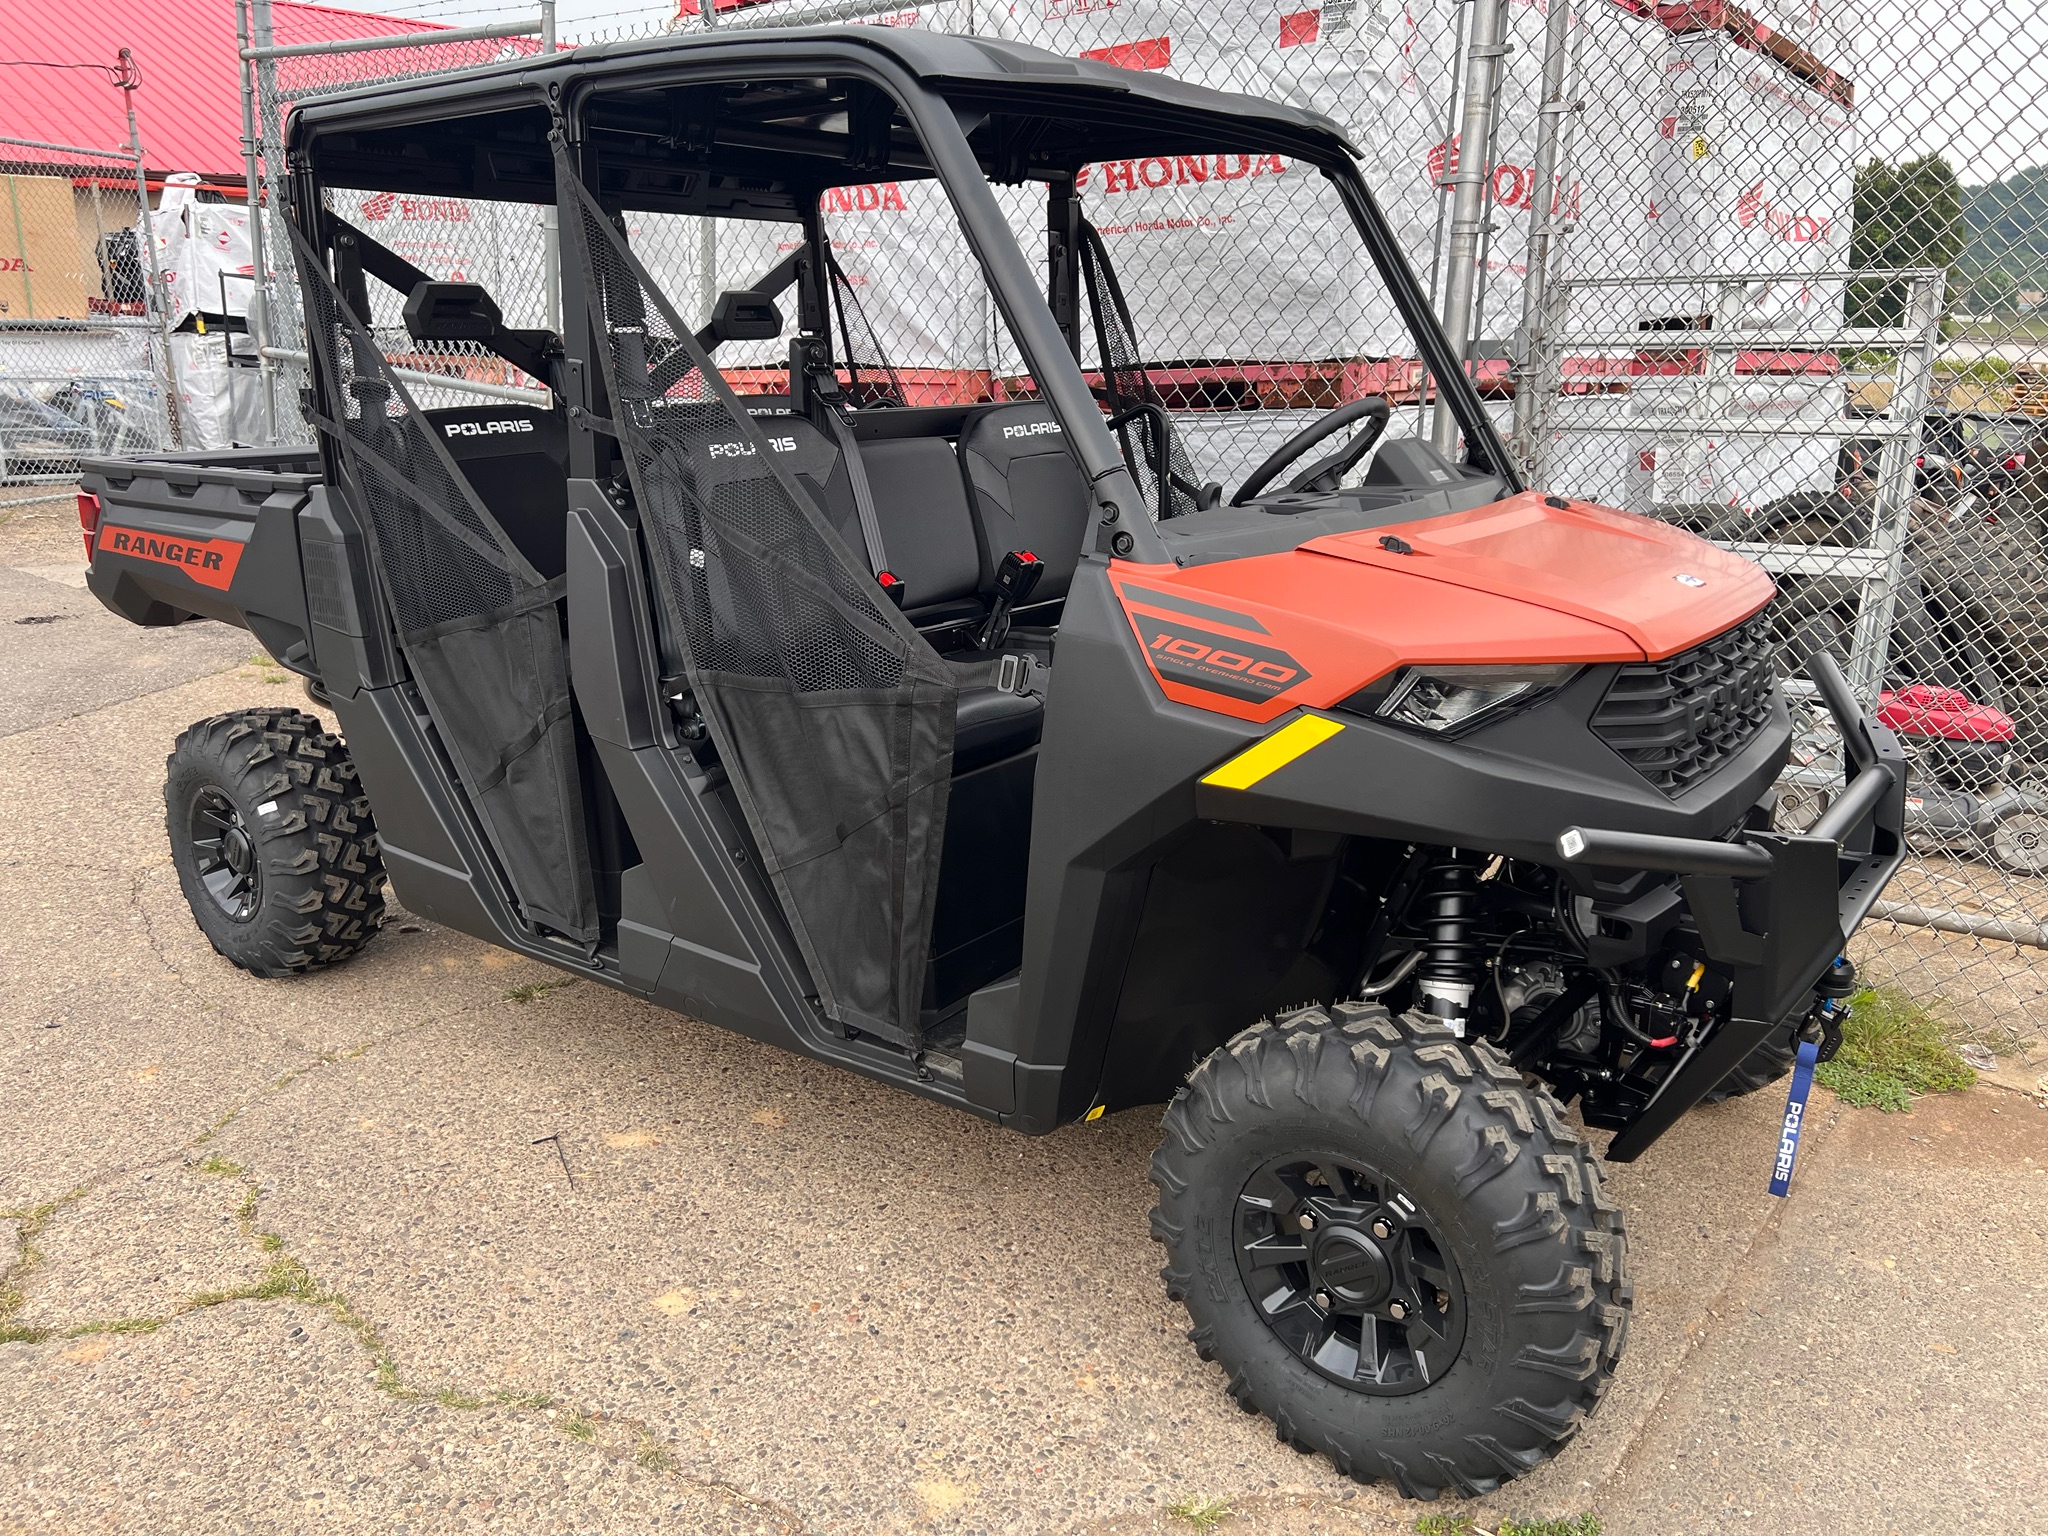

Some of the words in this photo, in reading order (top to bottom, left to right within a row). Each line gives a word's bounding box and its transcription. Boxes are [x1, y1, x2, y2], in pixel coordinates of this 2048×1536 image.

[1101, 153, 1286, 194] HONDA
[819, 181, 908, 213] NDA
[1096, 223, 1133, 236] merican
[1135, 220, 1164, 232] Honda
[1167, 216, 1194, 230] Motor
[444, 419, 534, 438] POLARIS
[1003, 421, 1062, 439] POLARIS
[113, 532, 224, 572] RANGER
[1149, 633, 1298, 684] 1000
[1155, 653, 1195, 668] SINGLE
[1197, 665, 1255, 685] OVERHEAD
[1256, 681, 1282, 691] CAM
[1774, 1100, 1802, 1182] POLARIS
[1325, 1260, 1370, 1278] RANGER
